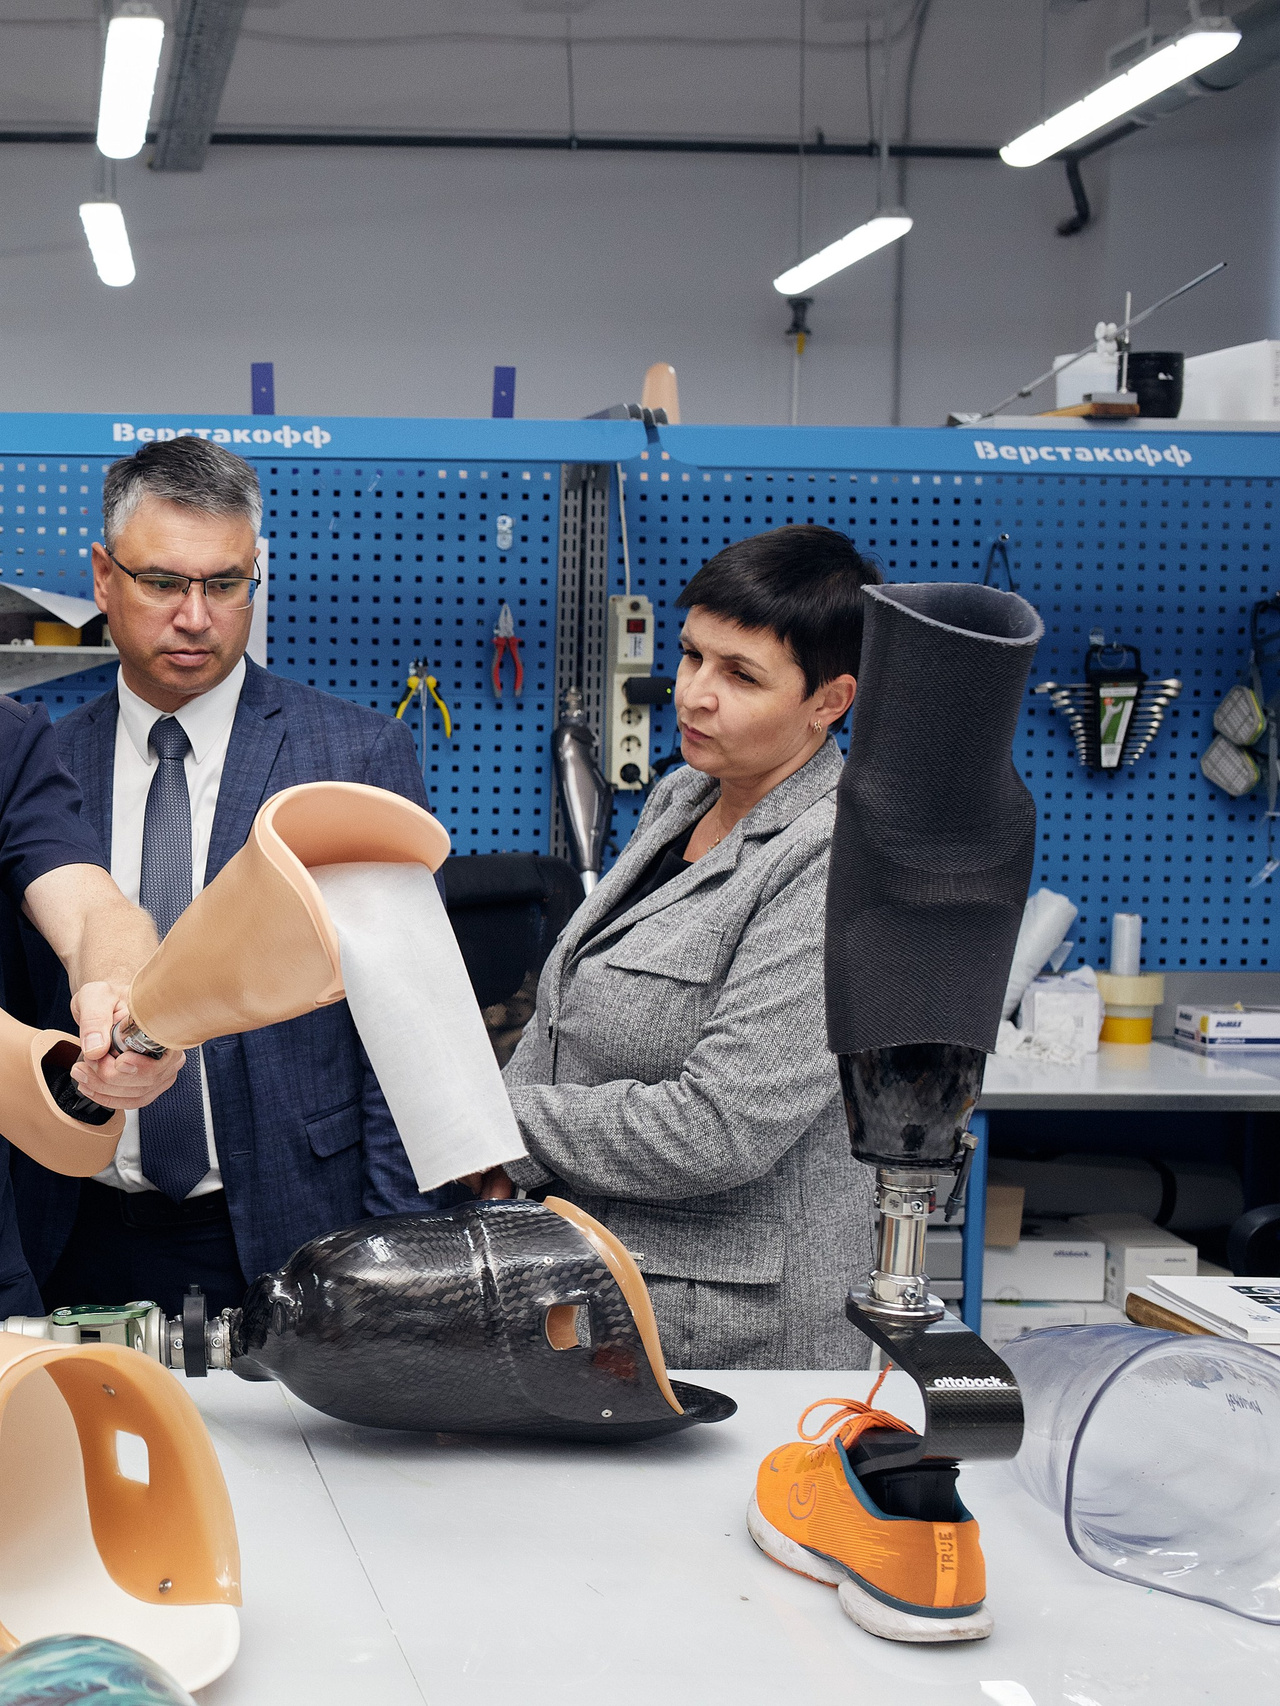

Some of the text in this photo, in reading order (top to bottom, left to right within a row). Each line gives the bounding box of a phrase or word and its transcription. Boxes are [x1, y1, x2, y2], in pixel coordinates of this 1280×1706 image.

[112, 422, 332, 449] Верстакофф
[974, 440, 1193, 468] Верстакофф
[933, 1376, 1008, 1388] ottobock.
[939, 1532, 955, 1573] TRUE
